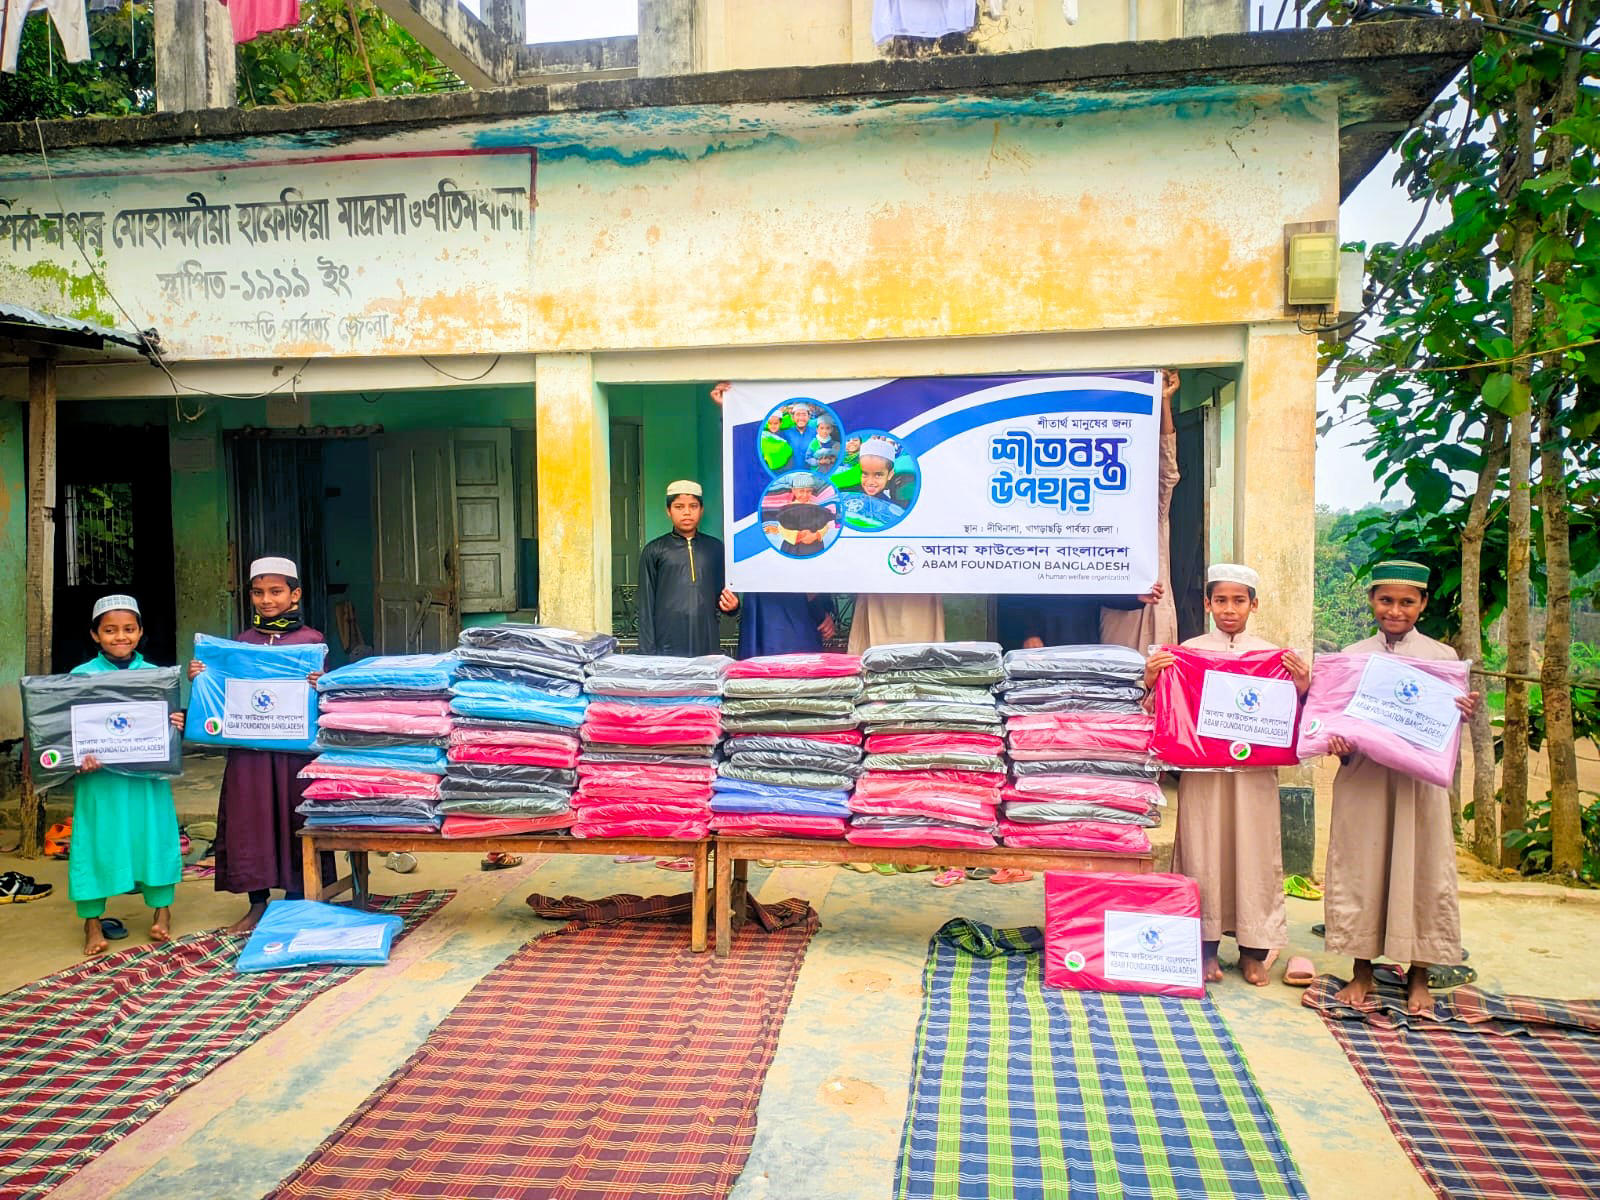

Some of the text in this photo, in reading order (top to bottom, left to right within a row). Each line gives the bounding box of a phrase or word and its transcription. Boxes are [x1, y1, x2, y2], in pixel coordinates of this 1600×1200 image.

[235, 187, 330, 246] হাফেজিয়া
[336, 193, 407, 238] মাদ্রাসা
[317, 256, 352, 298] ইং
[1072, 417, 1108, 431] মানুষের
[1111, 418, 1132, 429] জন্য
[992, 431, 1128, 491] শীতবস্ত্র
[992, 470, 1091, 512] উপহার
[922, 543, 1131, 558] আবাম ফাউন্ডেশন বাংলাদেশ
[922, 560, 1130, 571] ABAM FOUNDATION BANGLADESH
[1045, 573, 1067, 581] human
[1068, 573, 1090, 581] welfare
[240, 722, 271, 730] FOUNDATION
[1219, 720, 1253, 733] FOUNDATION
[1253, 725, 1288, 737] BANGLADESH
